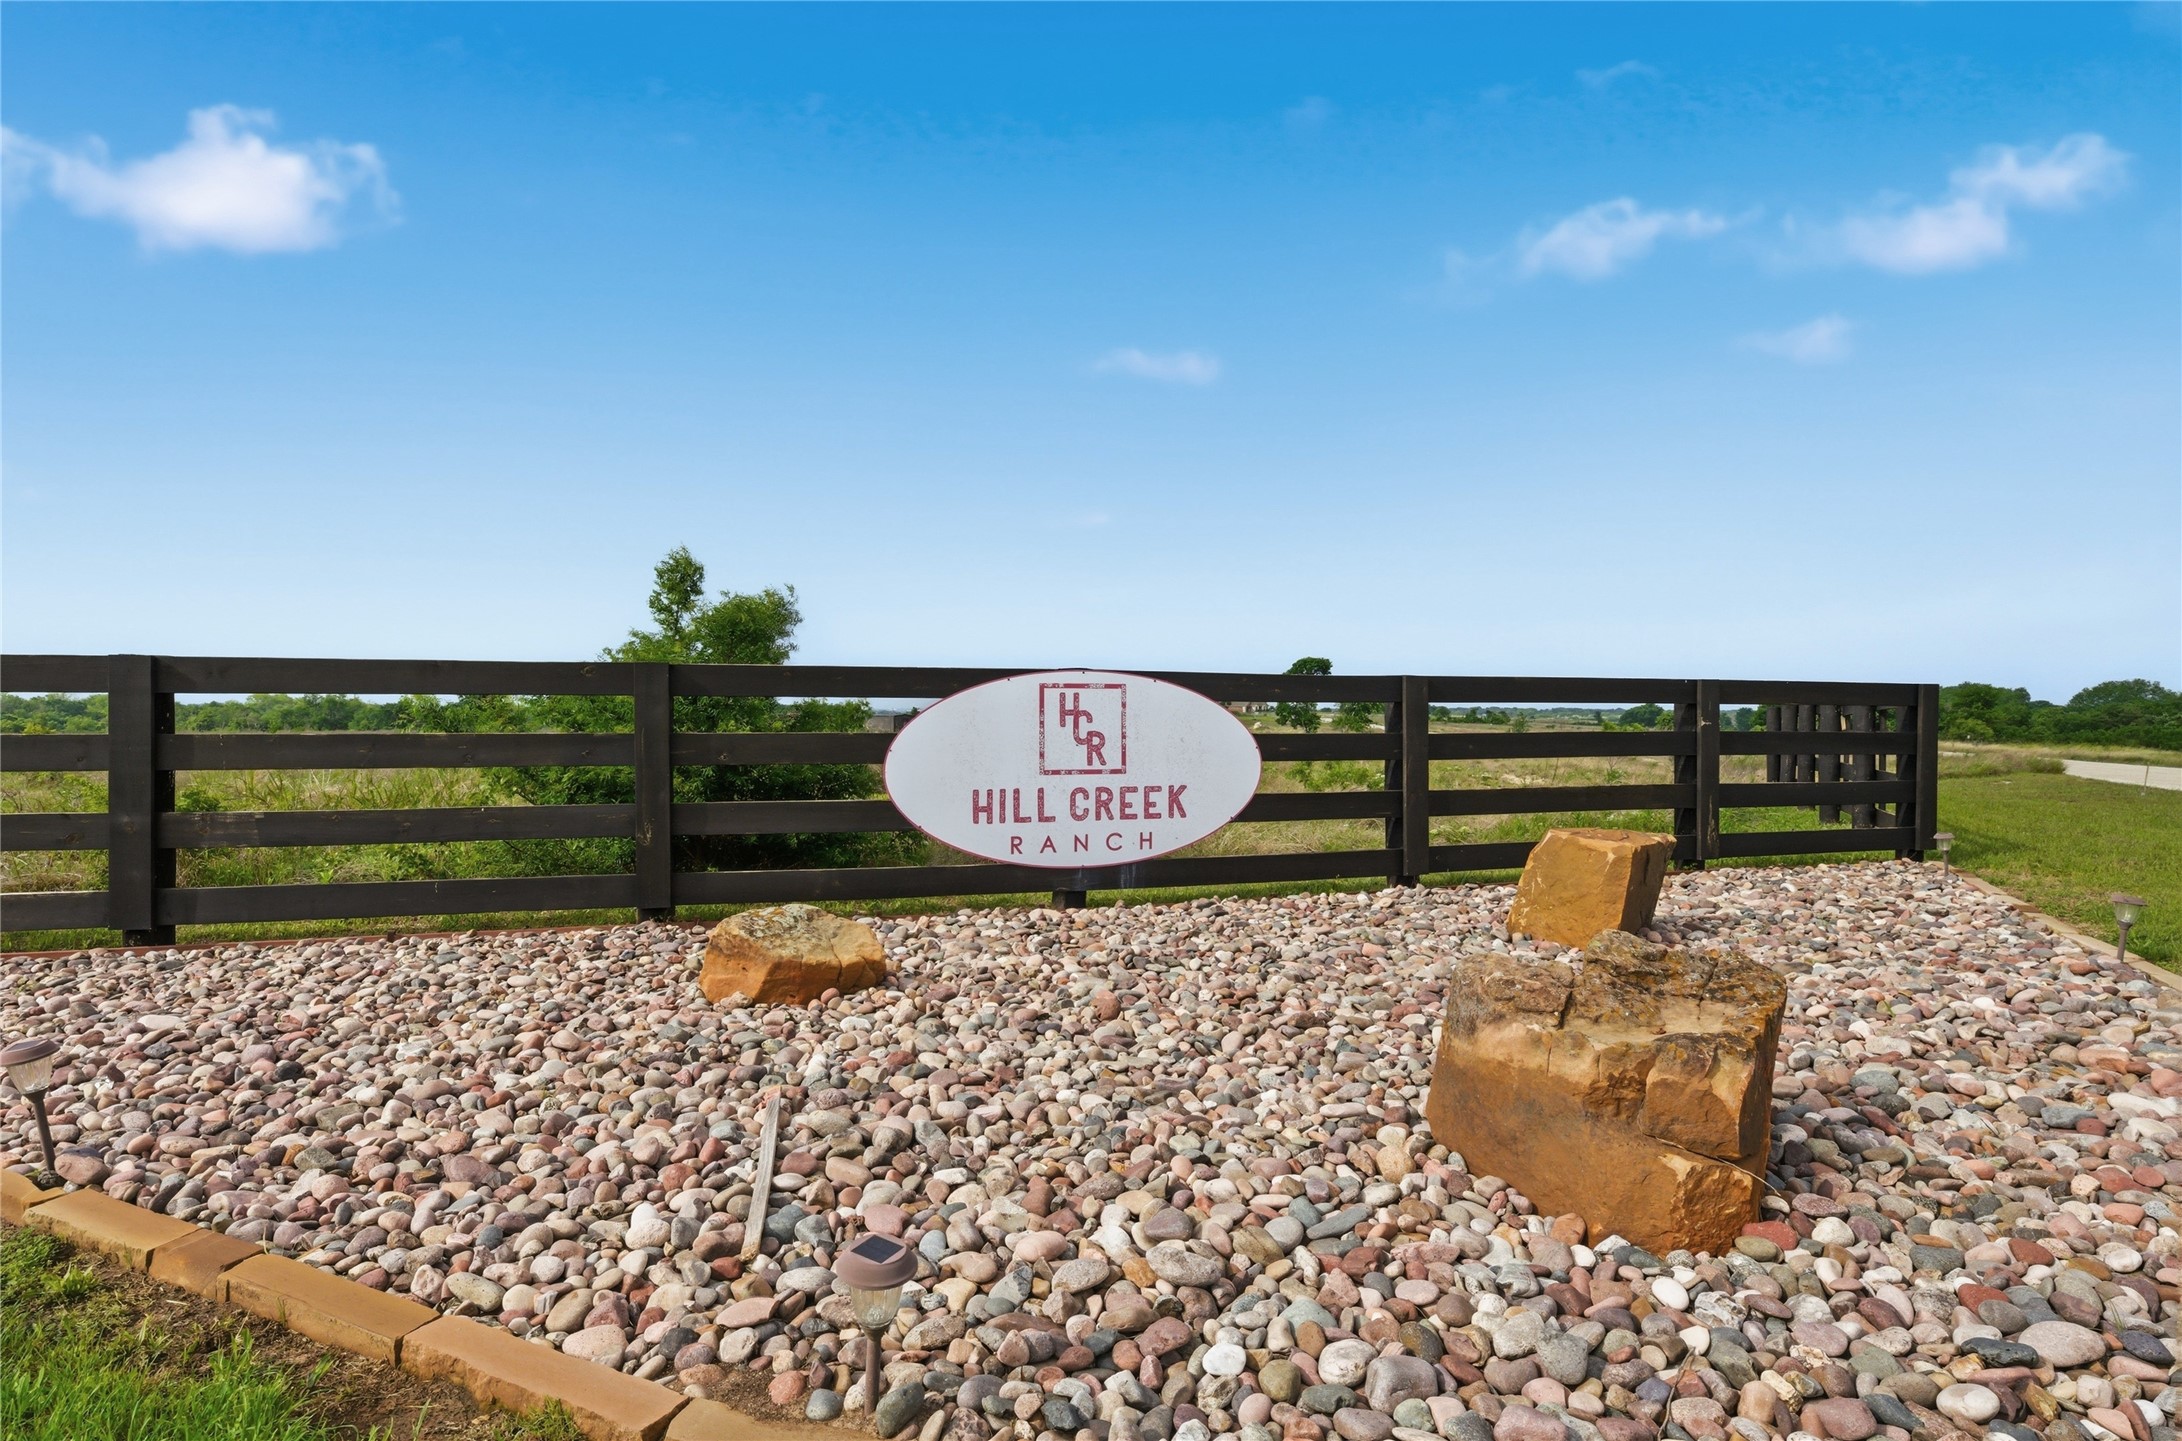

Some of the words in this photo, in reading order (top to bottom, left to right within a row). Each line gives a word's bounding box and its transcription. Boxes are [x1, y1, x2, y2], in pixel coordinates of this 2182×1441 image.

[1059, 692, 1107, 766] HCR
[972, 788, 1056, 825] HILL
[1069, 785, 1188, 822] CREEK
[1010, 831, 1153, 855] RANCH
